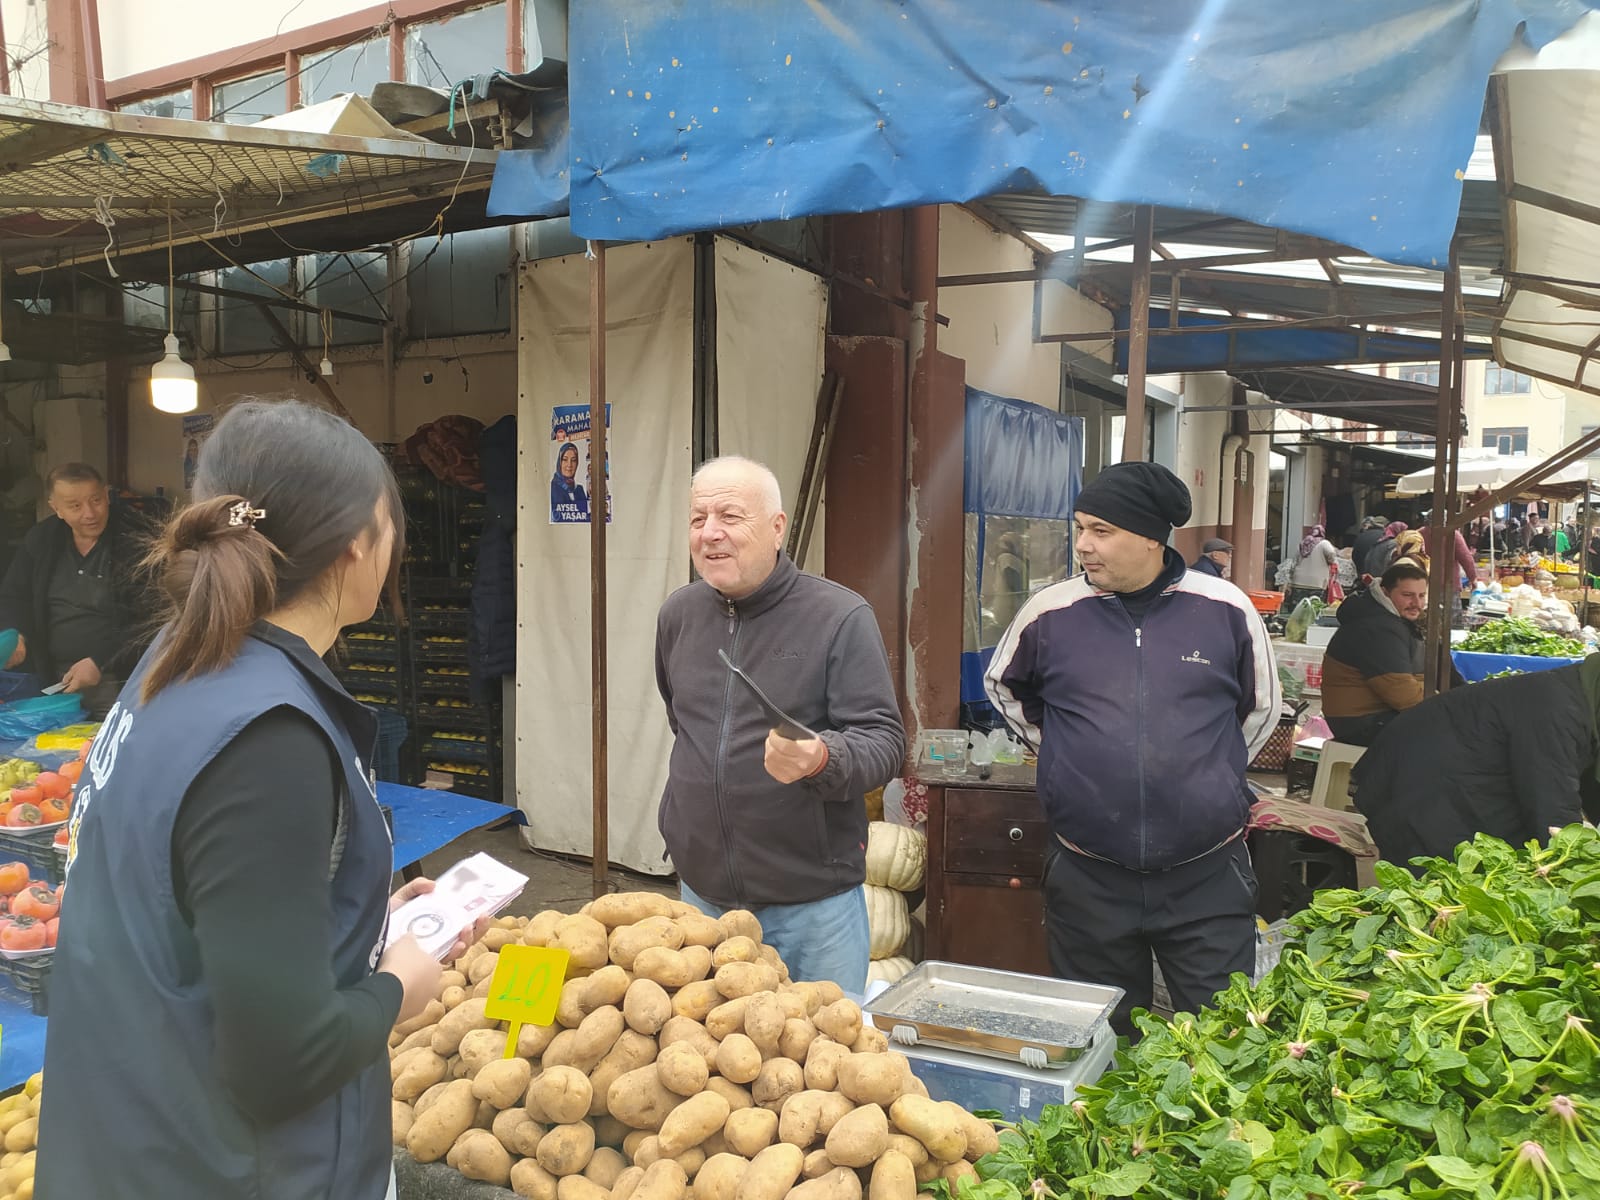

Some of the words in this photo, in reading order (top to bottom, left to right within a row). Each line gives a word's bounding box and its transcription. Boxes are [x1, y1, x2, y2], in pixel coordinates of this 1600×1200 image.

[553, 410, 591, 426] KARAMA
[556, 503, 579, 511] AYSEL
[561, 511, 587, 521] YAŞAR
